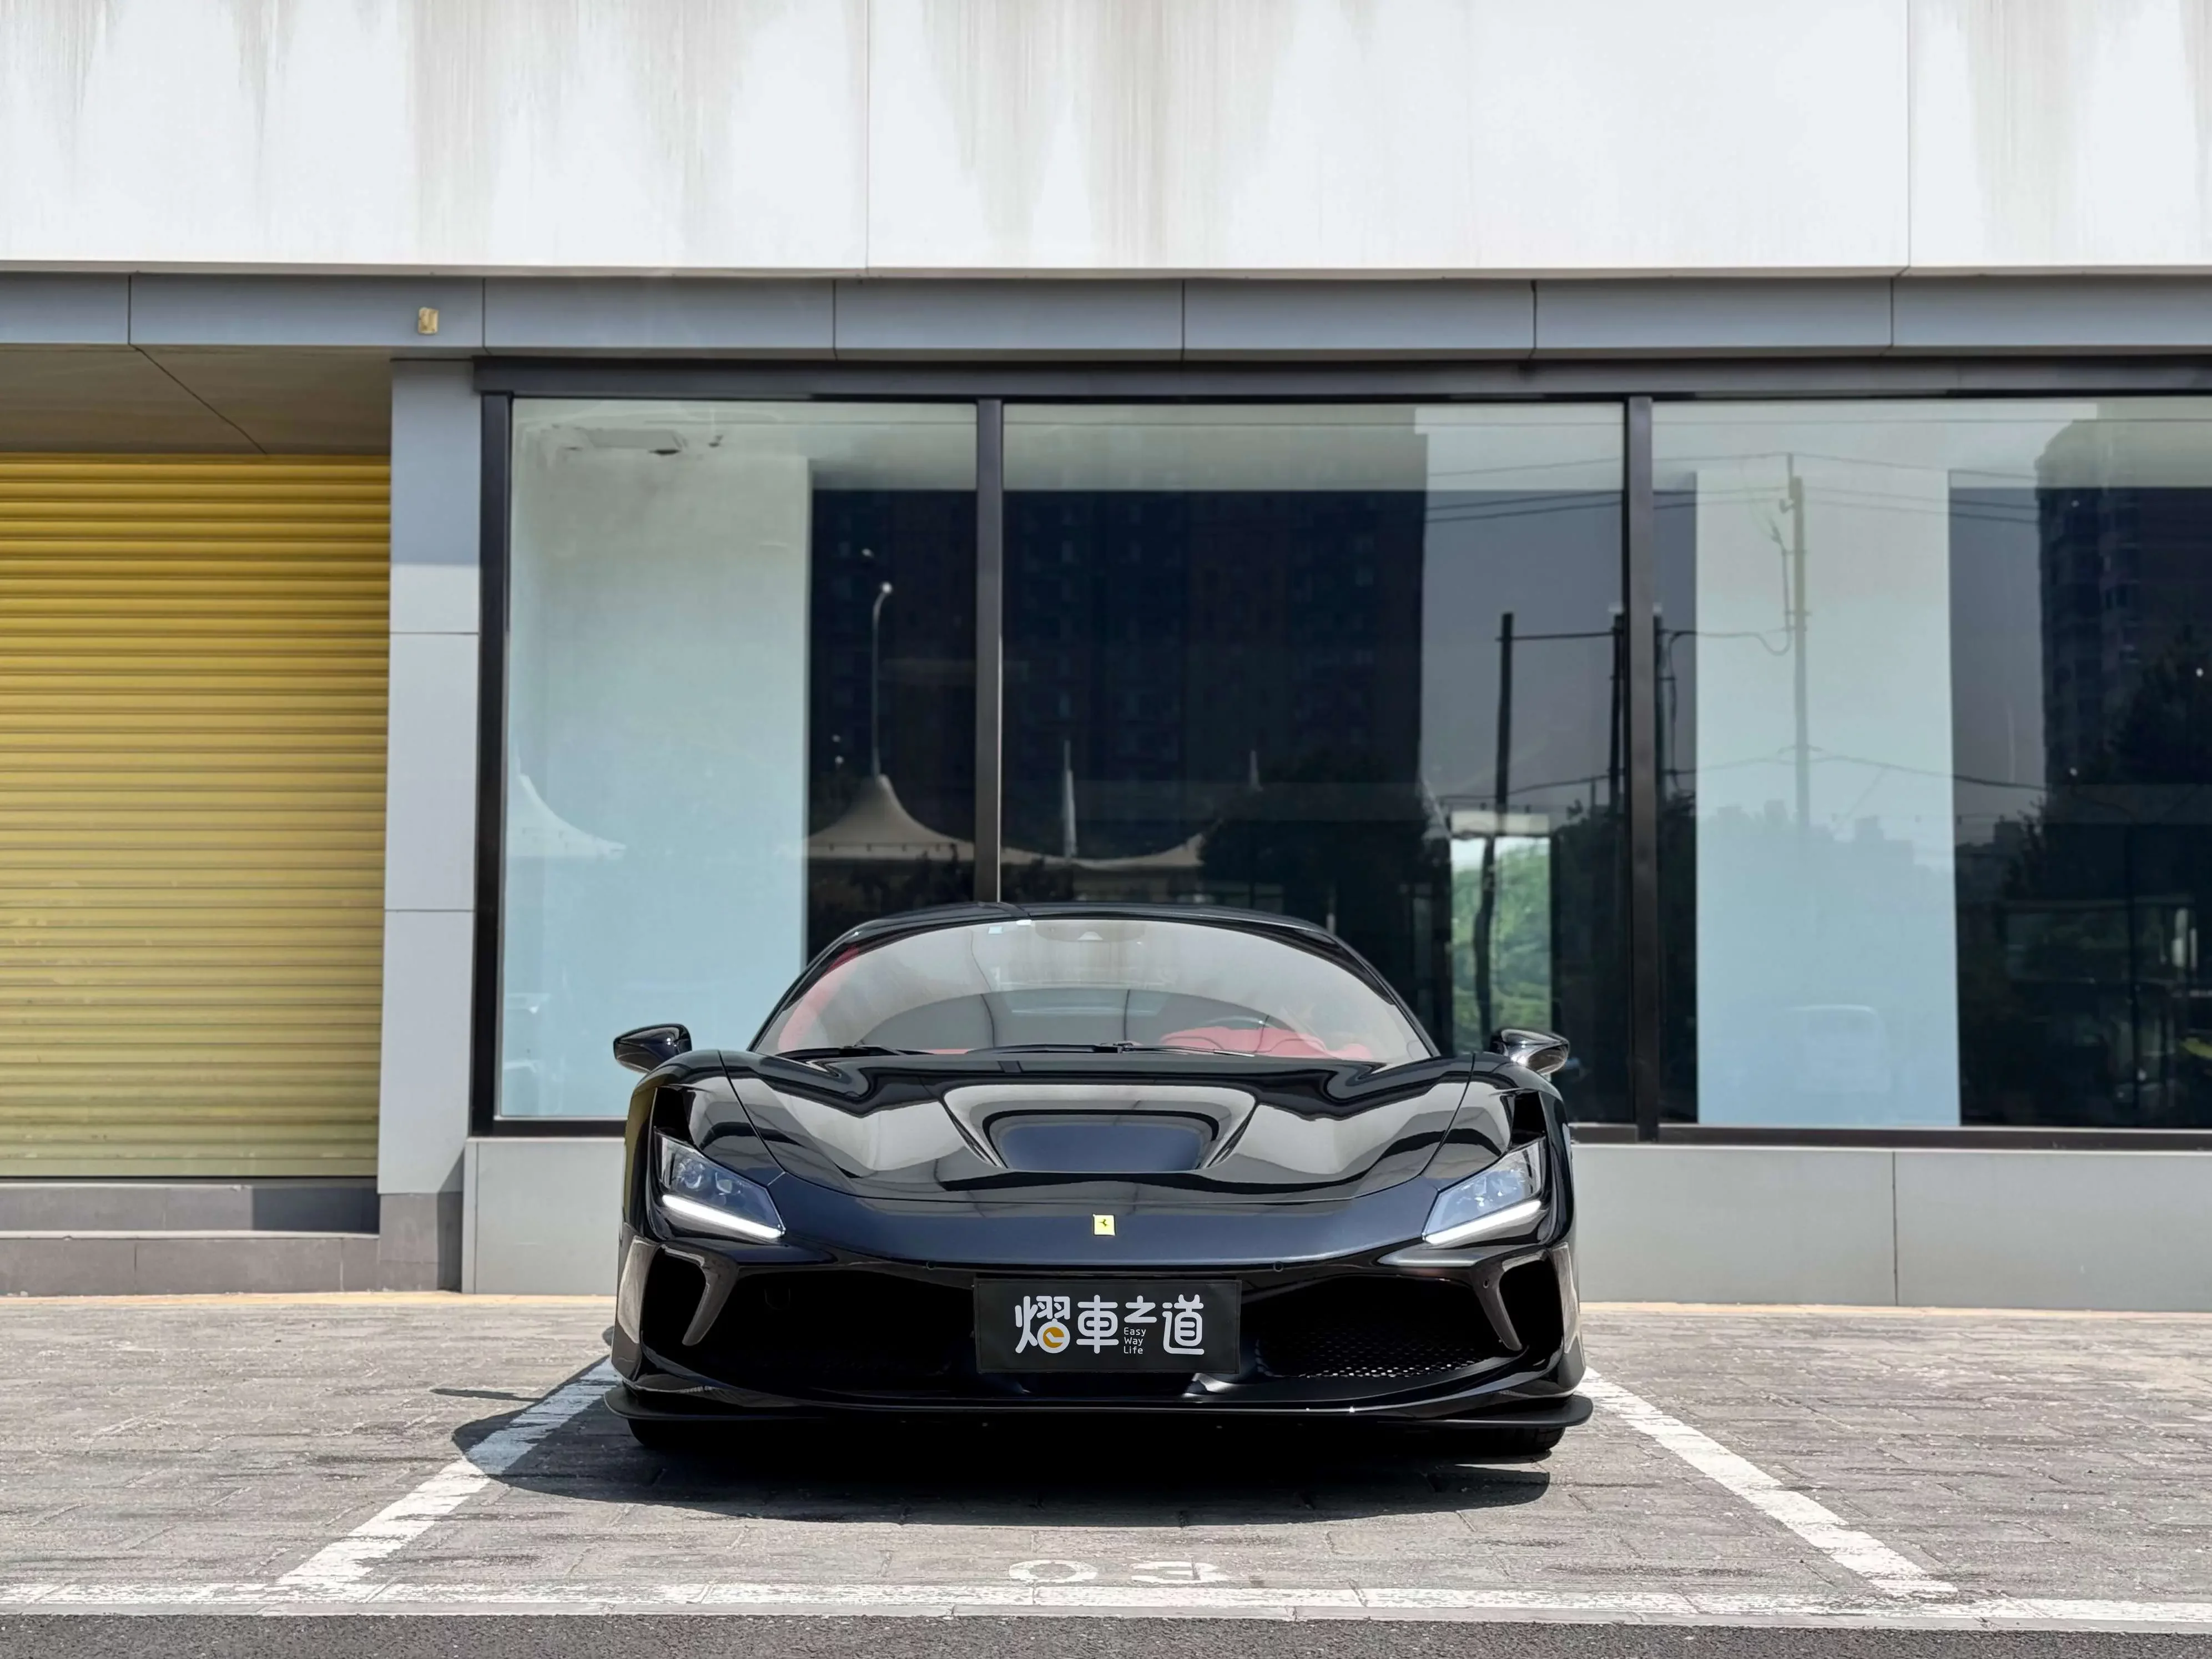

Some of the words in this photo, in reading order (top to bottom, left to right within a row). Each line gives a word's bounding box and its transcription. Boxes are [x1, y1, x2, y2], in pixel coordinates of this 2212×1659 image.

[1123, 1327, 1146, 1337] Easy
[1124, 1337, 1143, 1346] Way
[1123, 1345, 1143, 1354] Life
